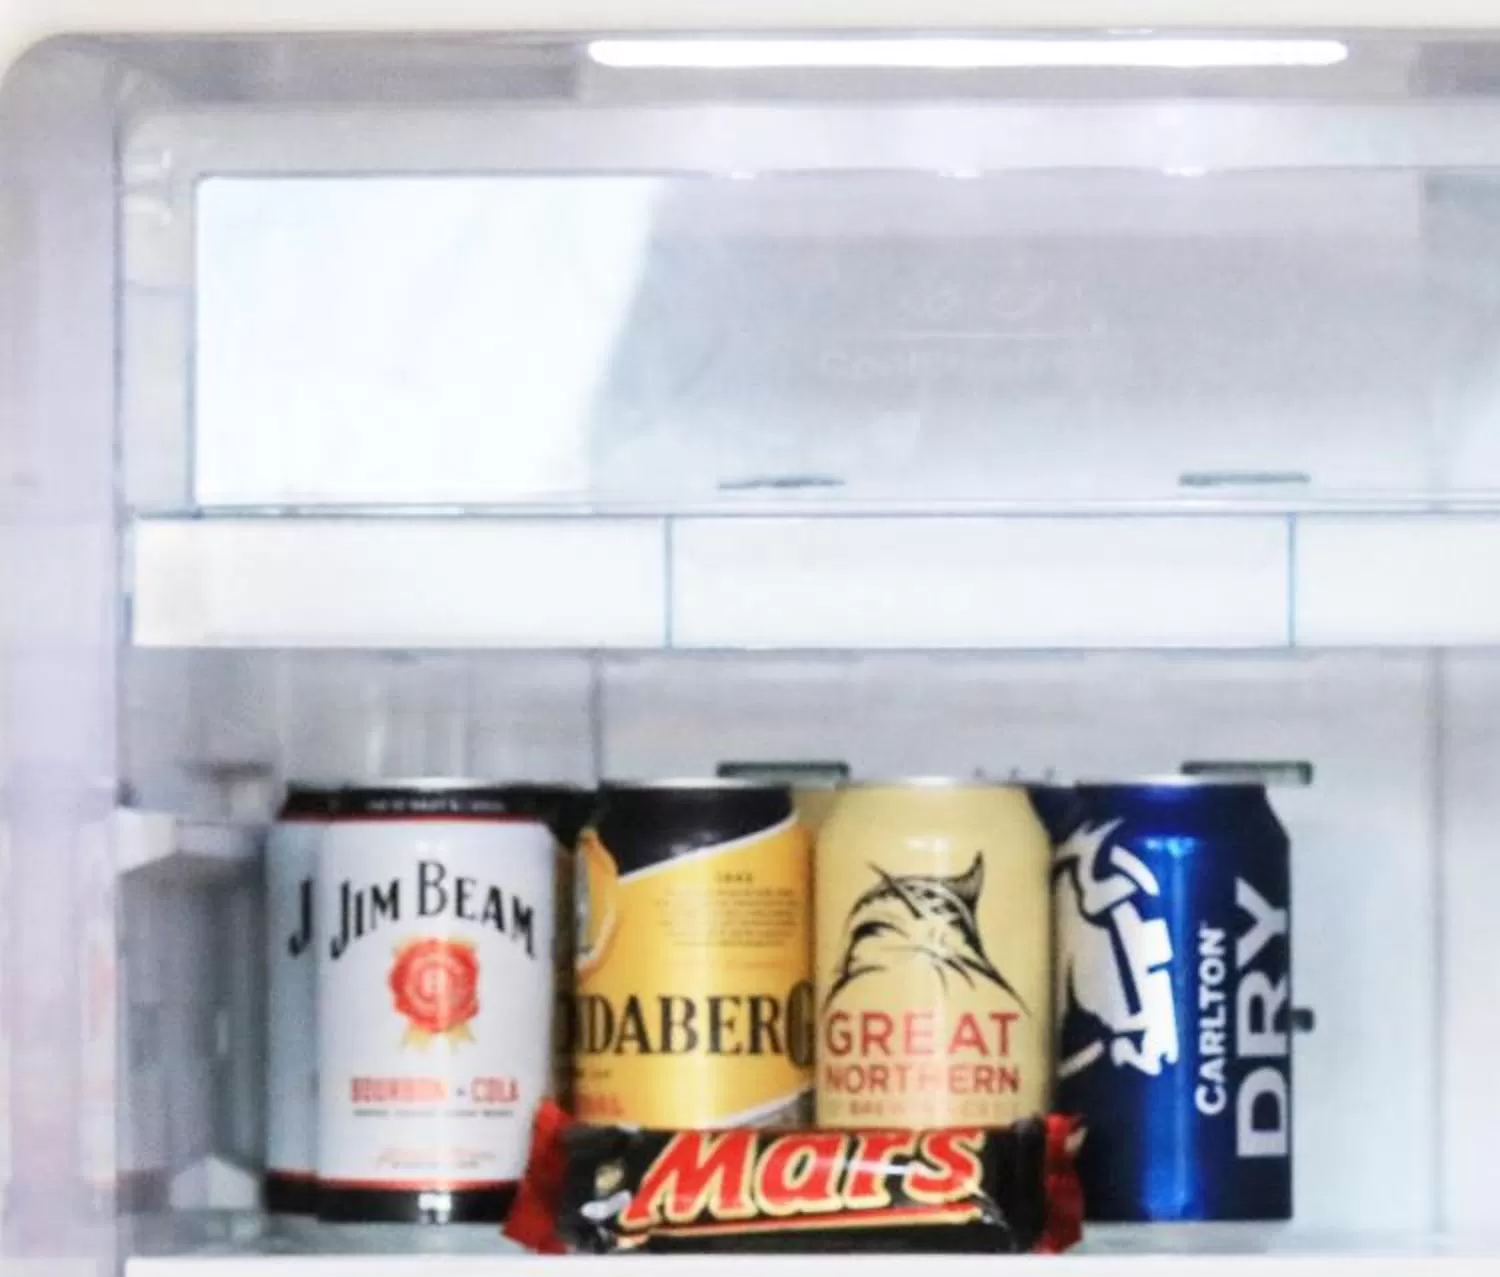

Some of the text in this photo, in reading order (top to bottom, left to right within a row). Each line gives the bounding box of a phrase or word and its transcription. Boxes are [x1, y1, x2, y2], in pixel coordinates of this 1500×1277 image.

[329, 859, 537, 961] JIM BEAM
[826, 1011, 1020, 1057] GREAT
[1195, 927, 1226, 1116] CARLTON
[1236, 876, 1289, 1158] DRY
[826, 1064, 1020, 1094] NORTHERN
[618, 1128, 986, 1229] Mars
